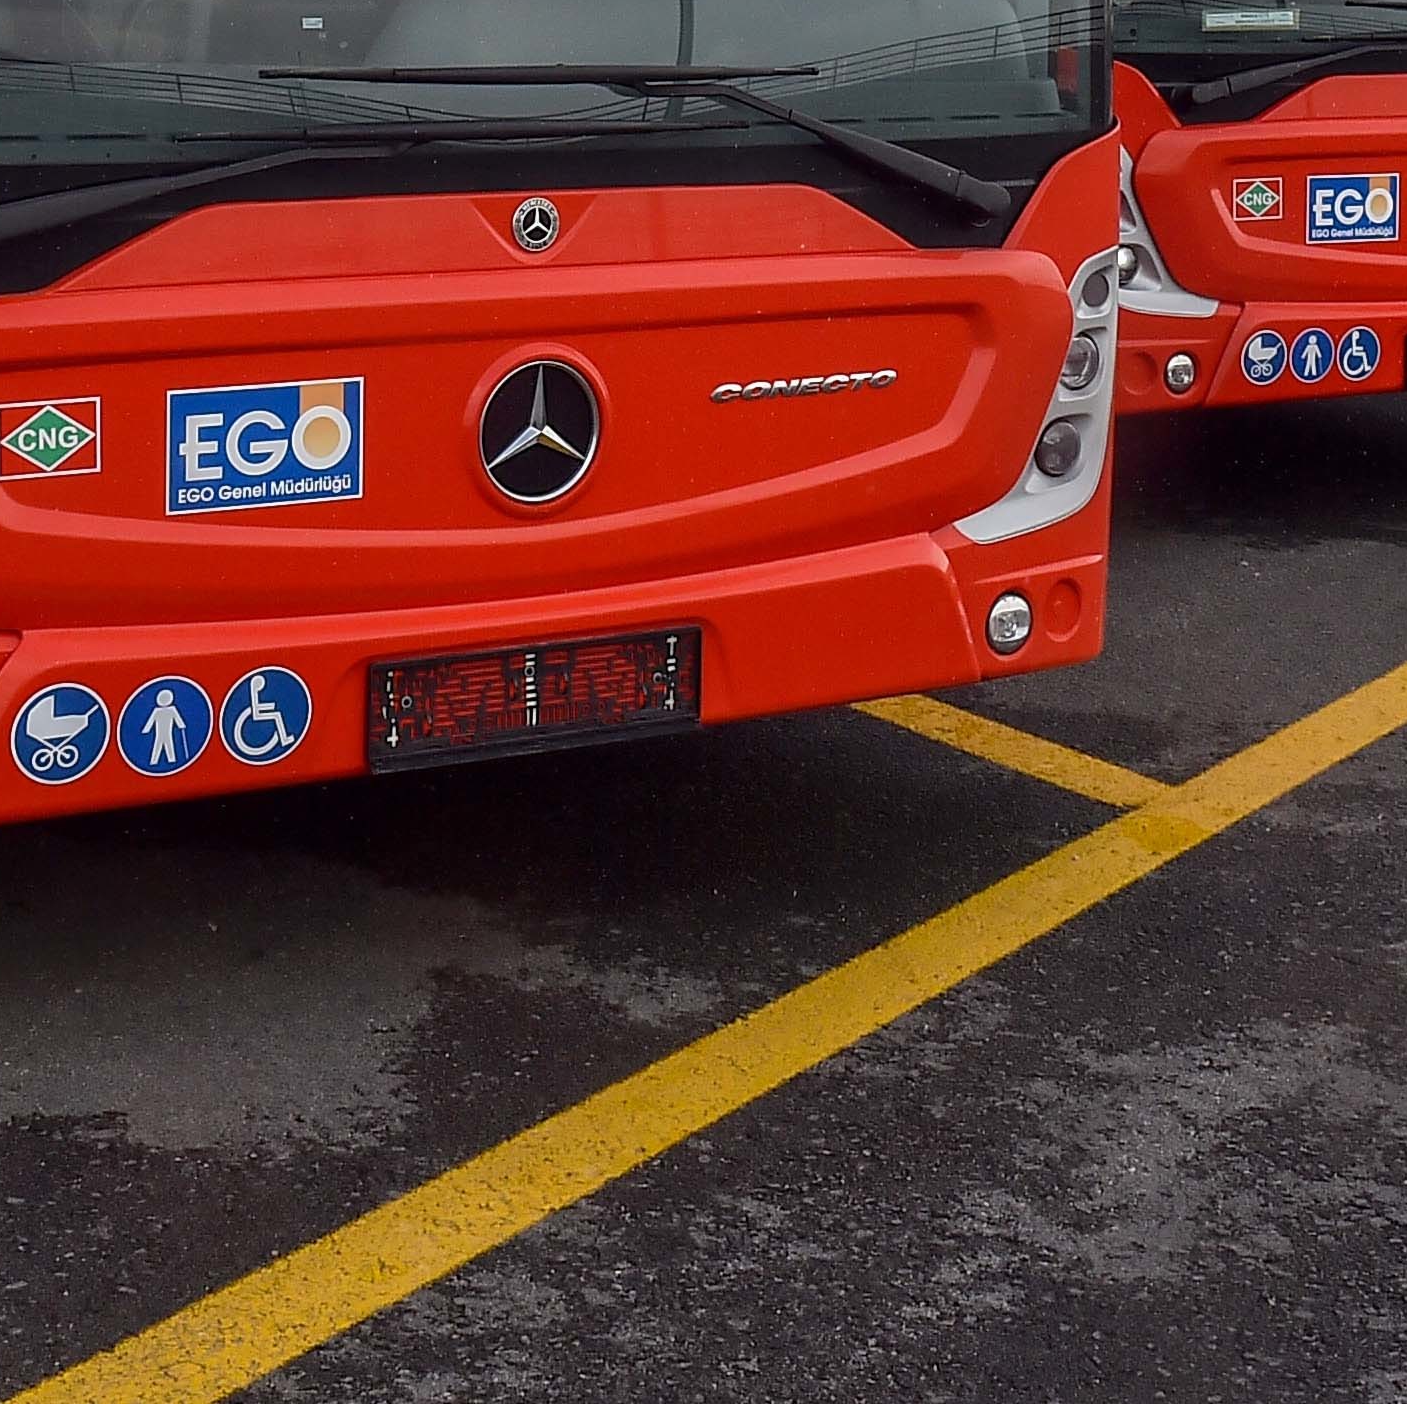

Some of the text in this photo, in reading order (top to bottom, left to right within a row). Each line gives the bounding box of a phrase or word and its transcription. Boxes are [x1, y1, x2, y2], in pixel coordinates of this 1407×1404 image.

[1243, 192, 1273, 207] CNG
[1312, 187, 1394, 227] EGO
[710, 369, 898, 404] CONECTO
[17, 426, 79, 453] CNG
[178, 405, 352, 482] EGO
[177, 472, 352, 505] EGO Genel Müdürlüğü
